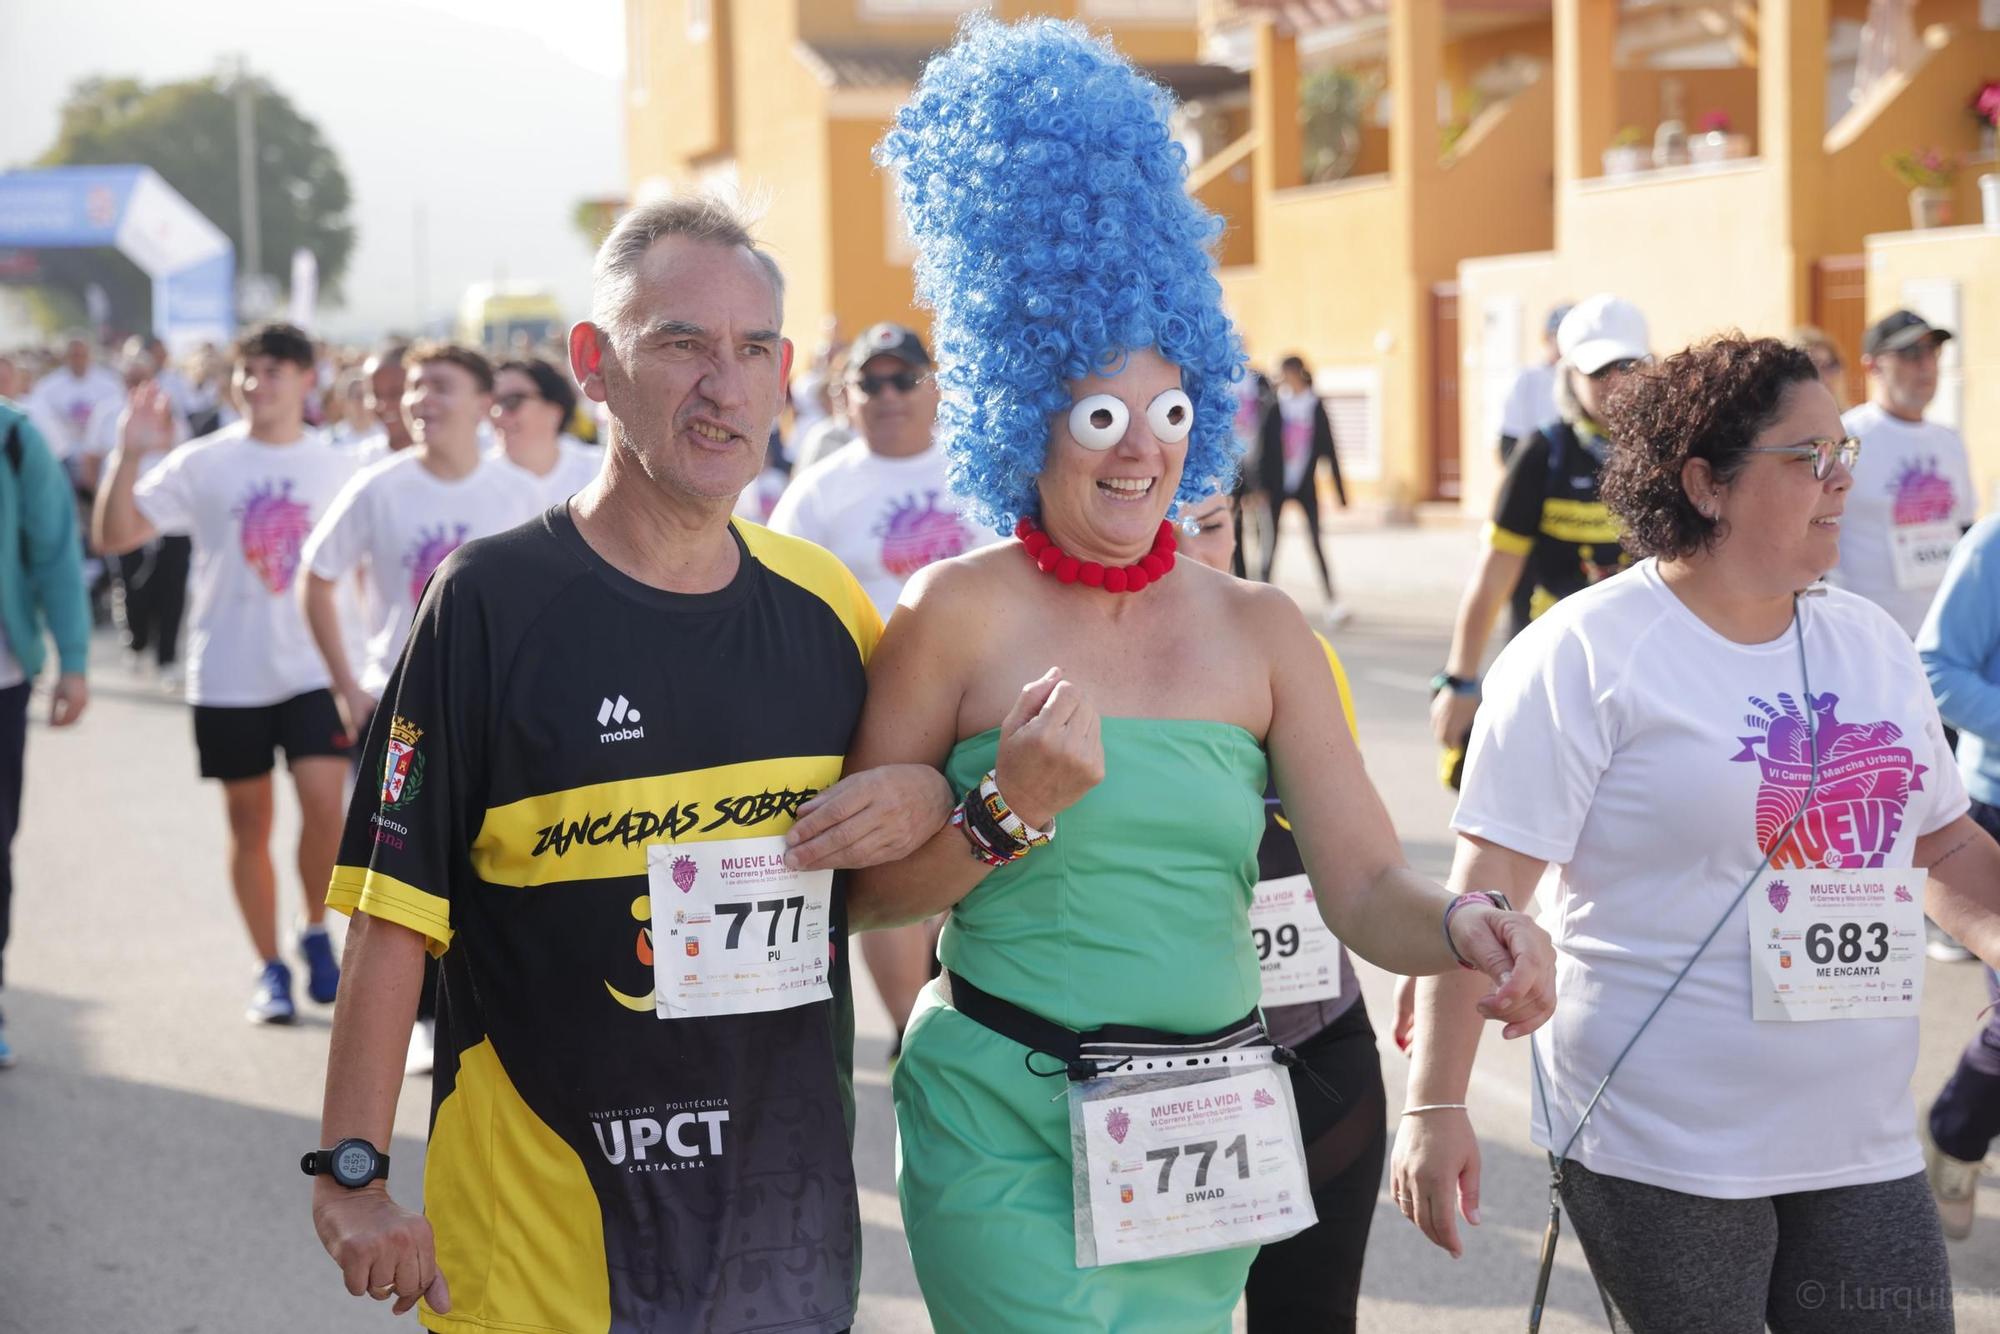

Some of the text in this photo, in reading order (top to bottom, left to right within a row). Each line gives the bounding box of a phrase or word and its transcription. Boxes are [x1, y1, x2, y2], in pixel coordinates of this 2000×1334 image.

[600, 726, 645, 743] mobel
[1822, 759, 1865, 778] Marcha
[1866, 754, 1907, 766] Urbana
[531, 800, 700, 858] ZANCADAS
[721, 854, 783, 870] MUEVE LA
[1825, 851, 1842, 864] la
[729, 870, 759, 878] Carrera
[1810, 884, 1885, 894] MUEVE LA VIDA
[714, 895, 805, 950] 777
[1805, 922, 1889, 964] 683
[768, 950, 781, 962] PU
[1816, 967, 1880, 977] ME ENCANTA
[588, 1098, 729, 1119] UNIVERSIDAD POLITÉCNICA
[1151, 1093, 1241, 1119] MUEVE LA VIDA
[592, 1110, 731, 1166] UPCT
[628, 1160, 705, 1174] CARTAGENA
[1146, 1134, 1250, 1194] 771
[1185, 1188, 1225, 1204] BWAD
